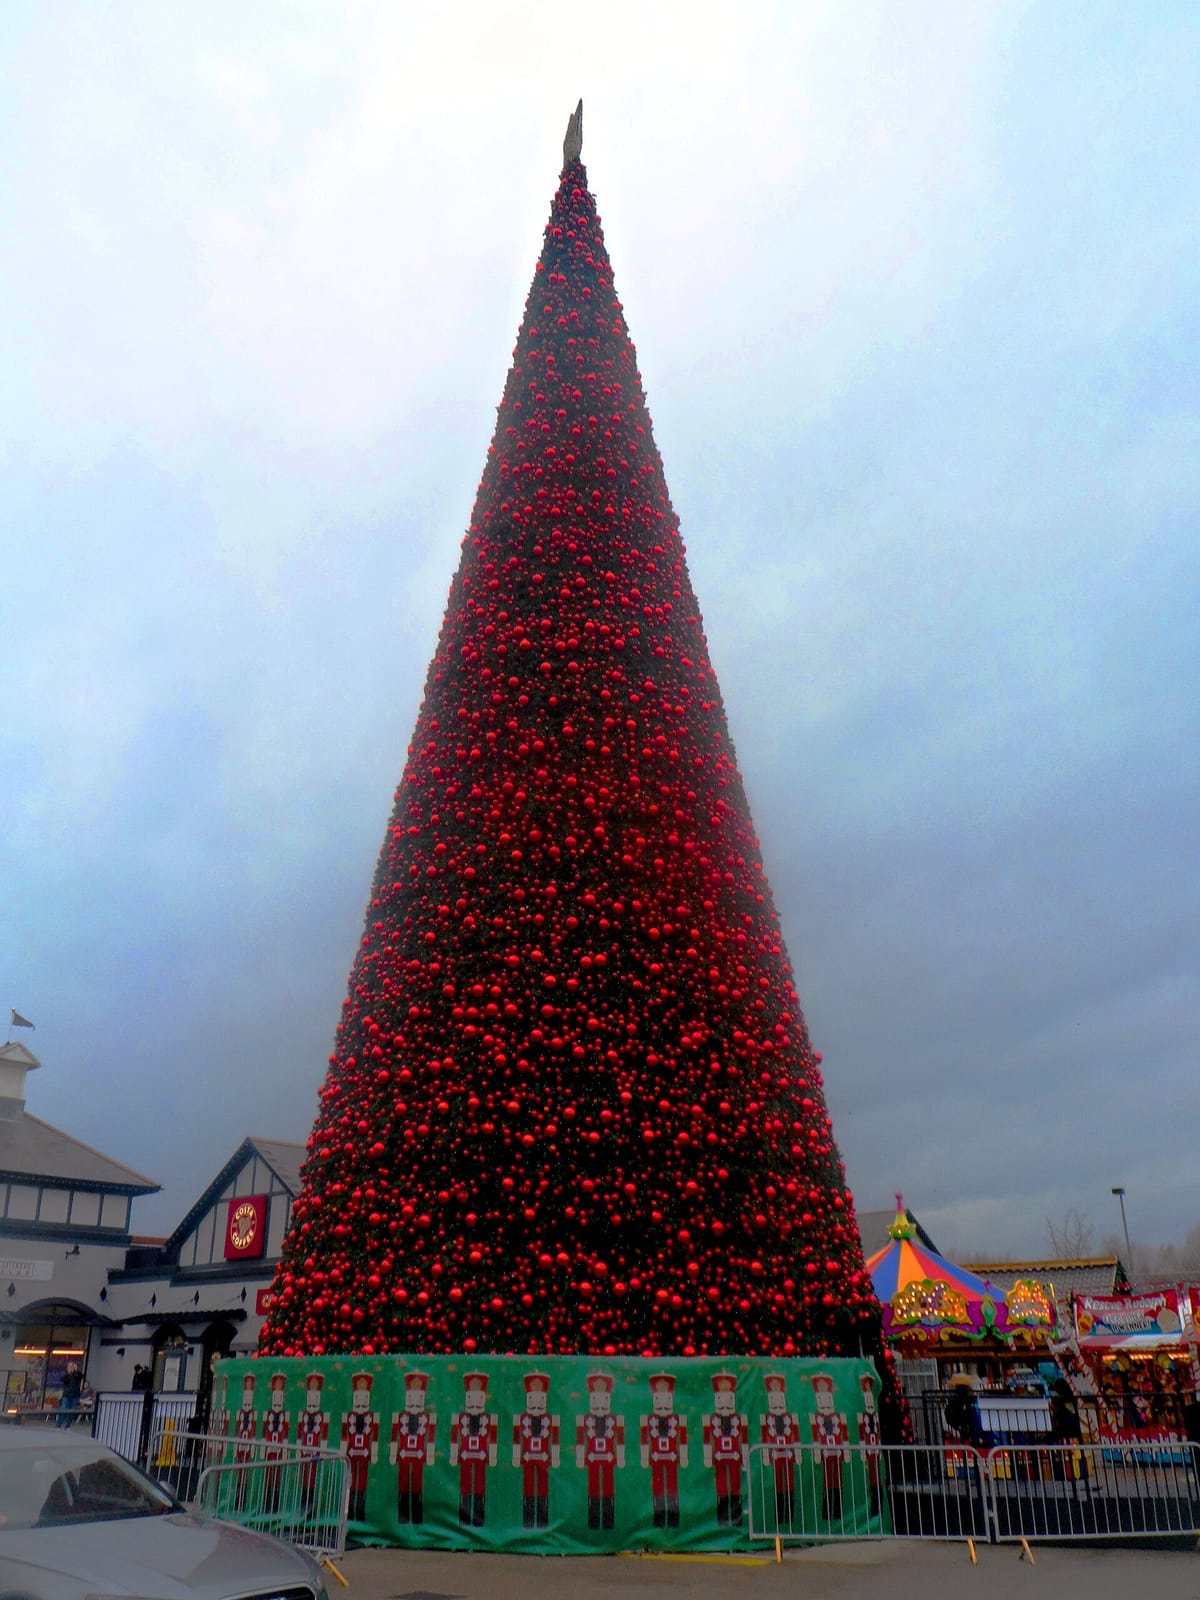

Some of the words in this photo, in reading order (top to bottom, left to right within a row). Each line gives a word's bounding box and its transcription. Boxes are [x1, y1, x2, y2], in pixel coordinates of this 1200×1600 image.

[235, 1205, 254, 1220] COSTA
[232, 1230, 254, 1247] COFFEE
[1123, 1293, 1167, 1312] Rudolph
